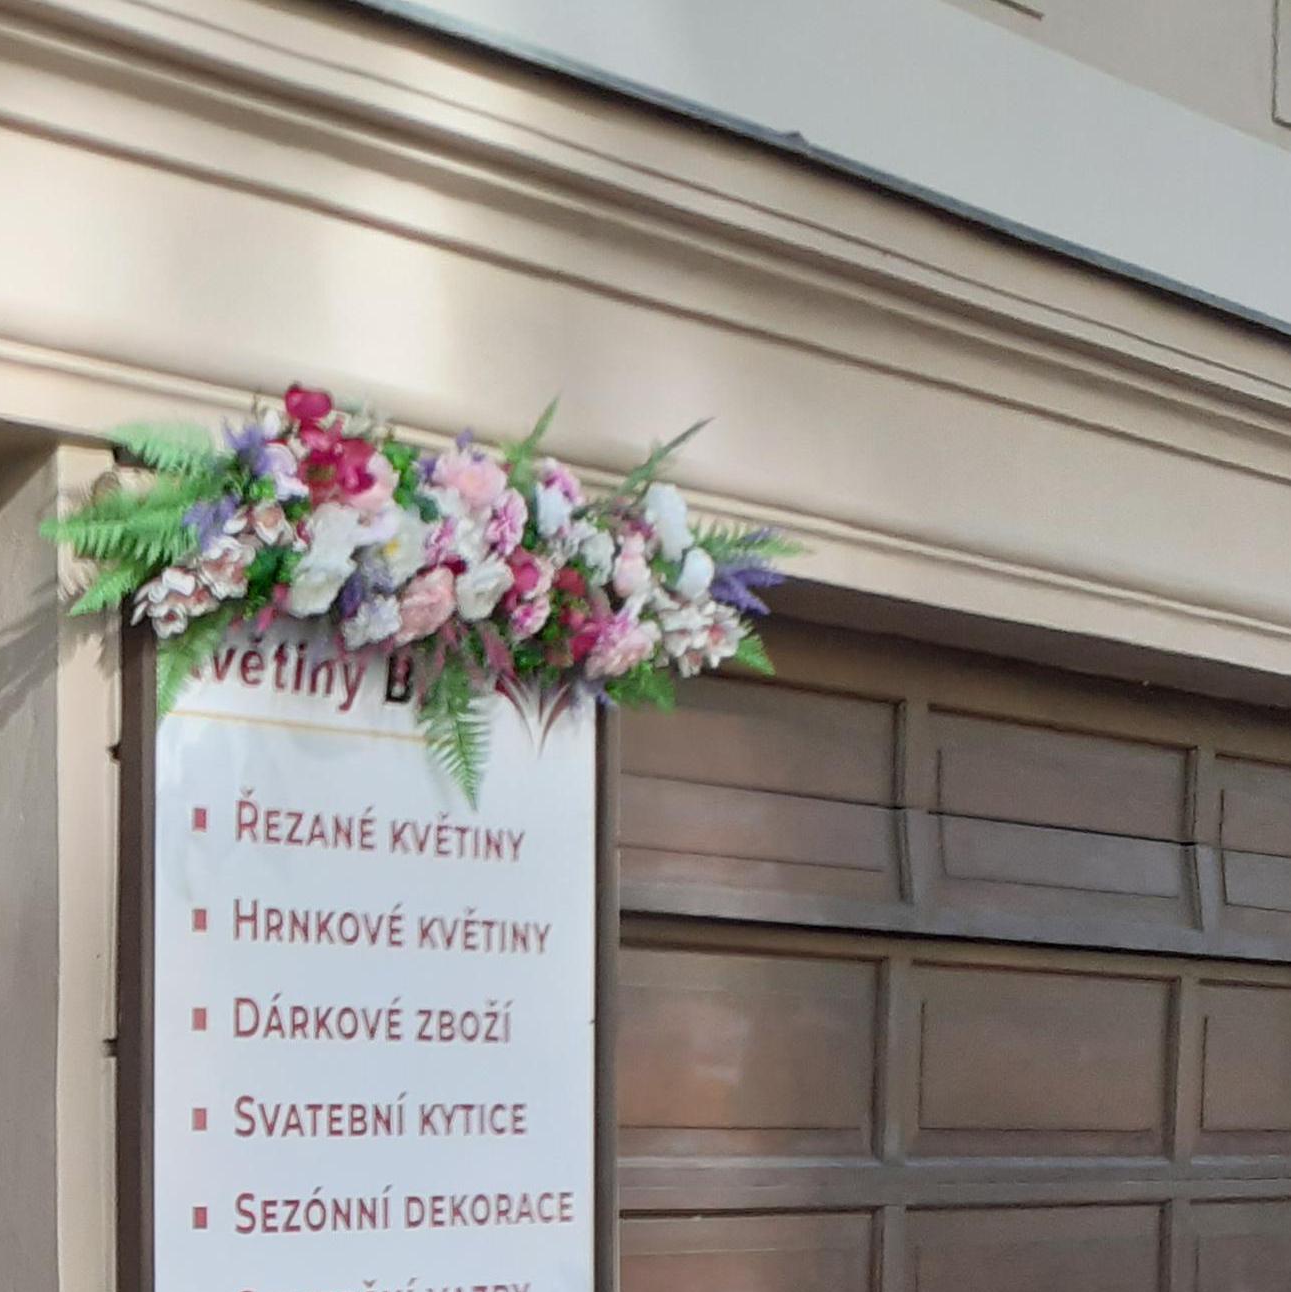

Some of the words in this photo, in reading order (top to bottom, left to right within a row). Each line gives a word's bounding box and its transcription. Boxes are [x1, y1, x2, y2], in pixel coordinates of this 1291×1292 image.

[193, 636, 366, 713] větiny
[235, 788, 376, 851] ŘEZANÉ
[389, 813, 526, 862] KVĚTINY
[233, 898, 402, 948] HRNKOVÉ
[418, 907, 553, 954] KVĚTINY
[233, 993, 402, 1042] DÁRKOVÉ
[416, 1000, 512, 1043] ZBOŽÍ
[234, 1092, 407, 1137] SVATEBNÍ
[418, 1103, 528, 1136] KYTICE
[234, 1185, 393, 1234] SEZÓNNÍ
[404, 1192, 574, 1228] DEKORACE
